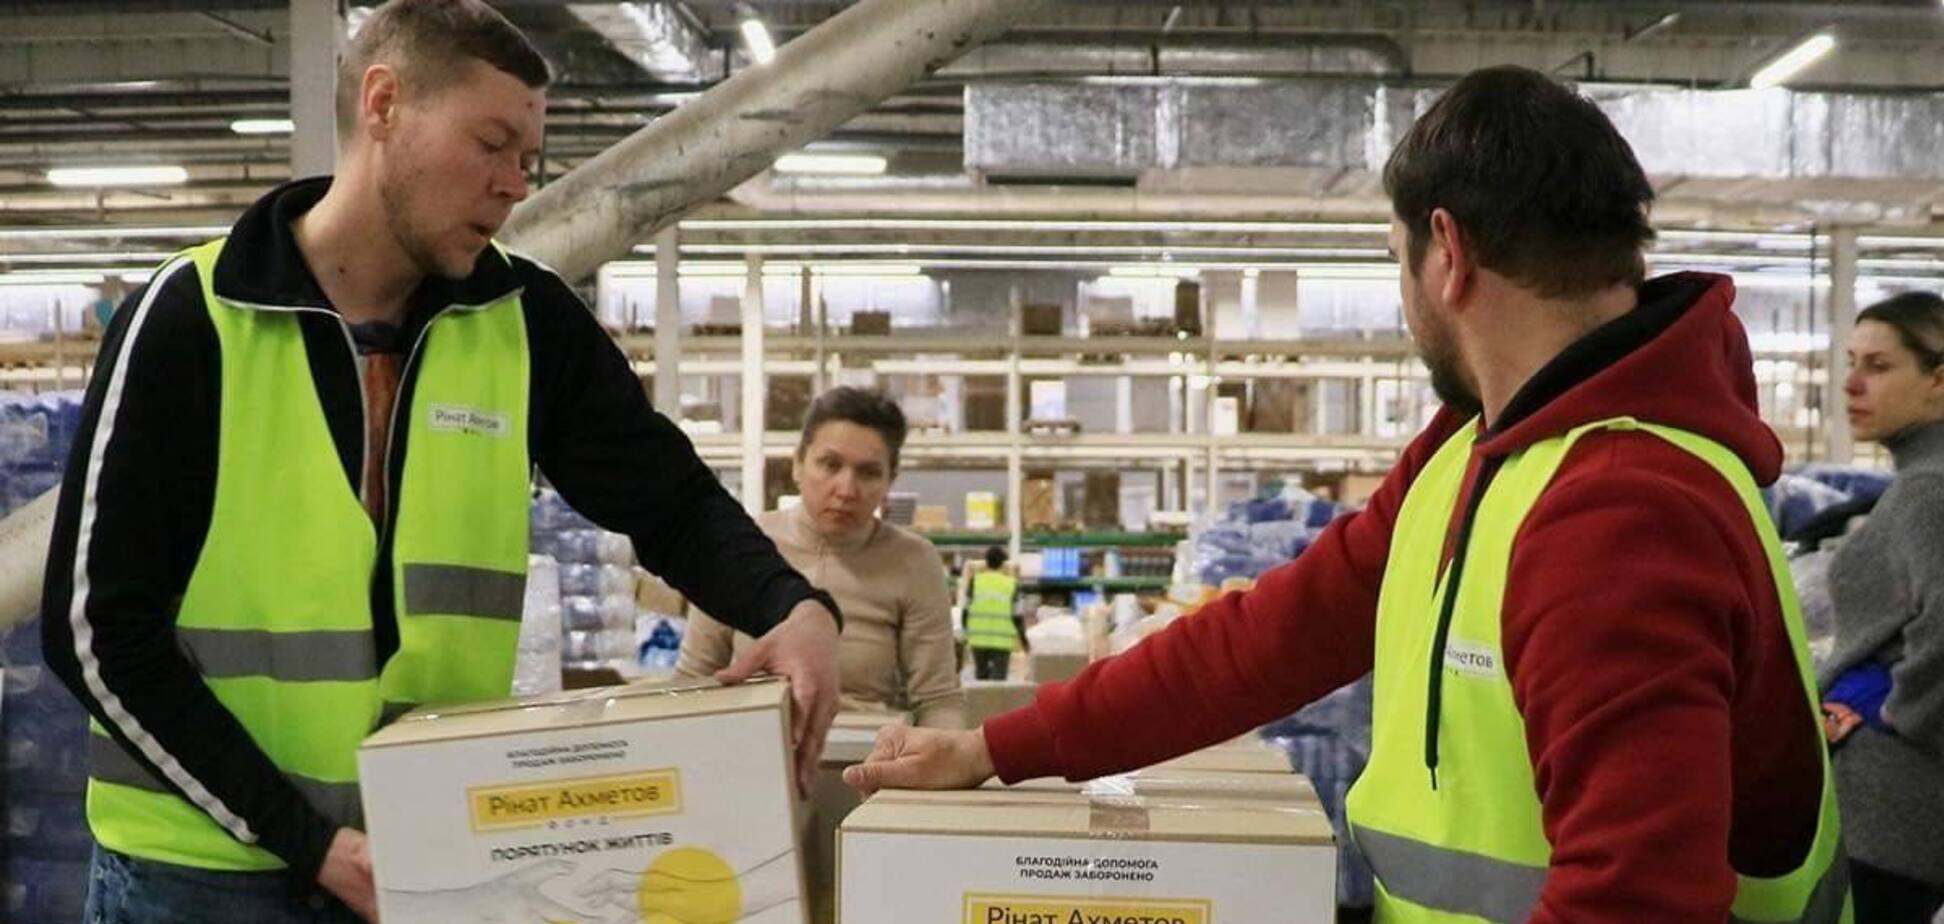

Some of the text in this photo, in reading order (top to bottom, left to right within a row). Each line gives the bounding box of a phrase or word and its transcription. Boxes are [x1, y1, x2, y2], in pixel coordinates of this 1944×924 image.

[488, 785, 661, 816] Рінат Ахметов
[490, 831, 675, 861] ПОРЯТУНОК ЖИТТІВ
[1015, 855, 1160, 870] БЛАГОДІЙНА ДОПОМОГА
[1020, 868, 1155, 882] ПРОДАЖ ЗАБОРОНЕНО
